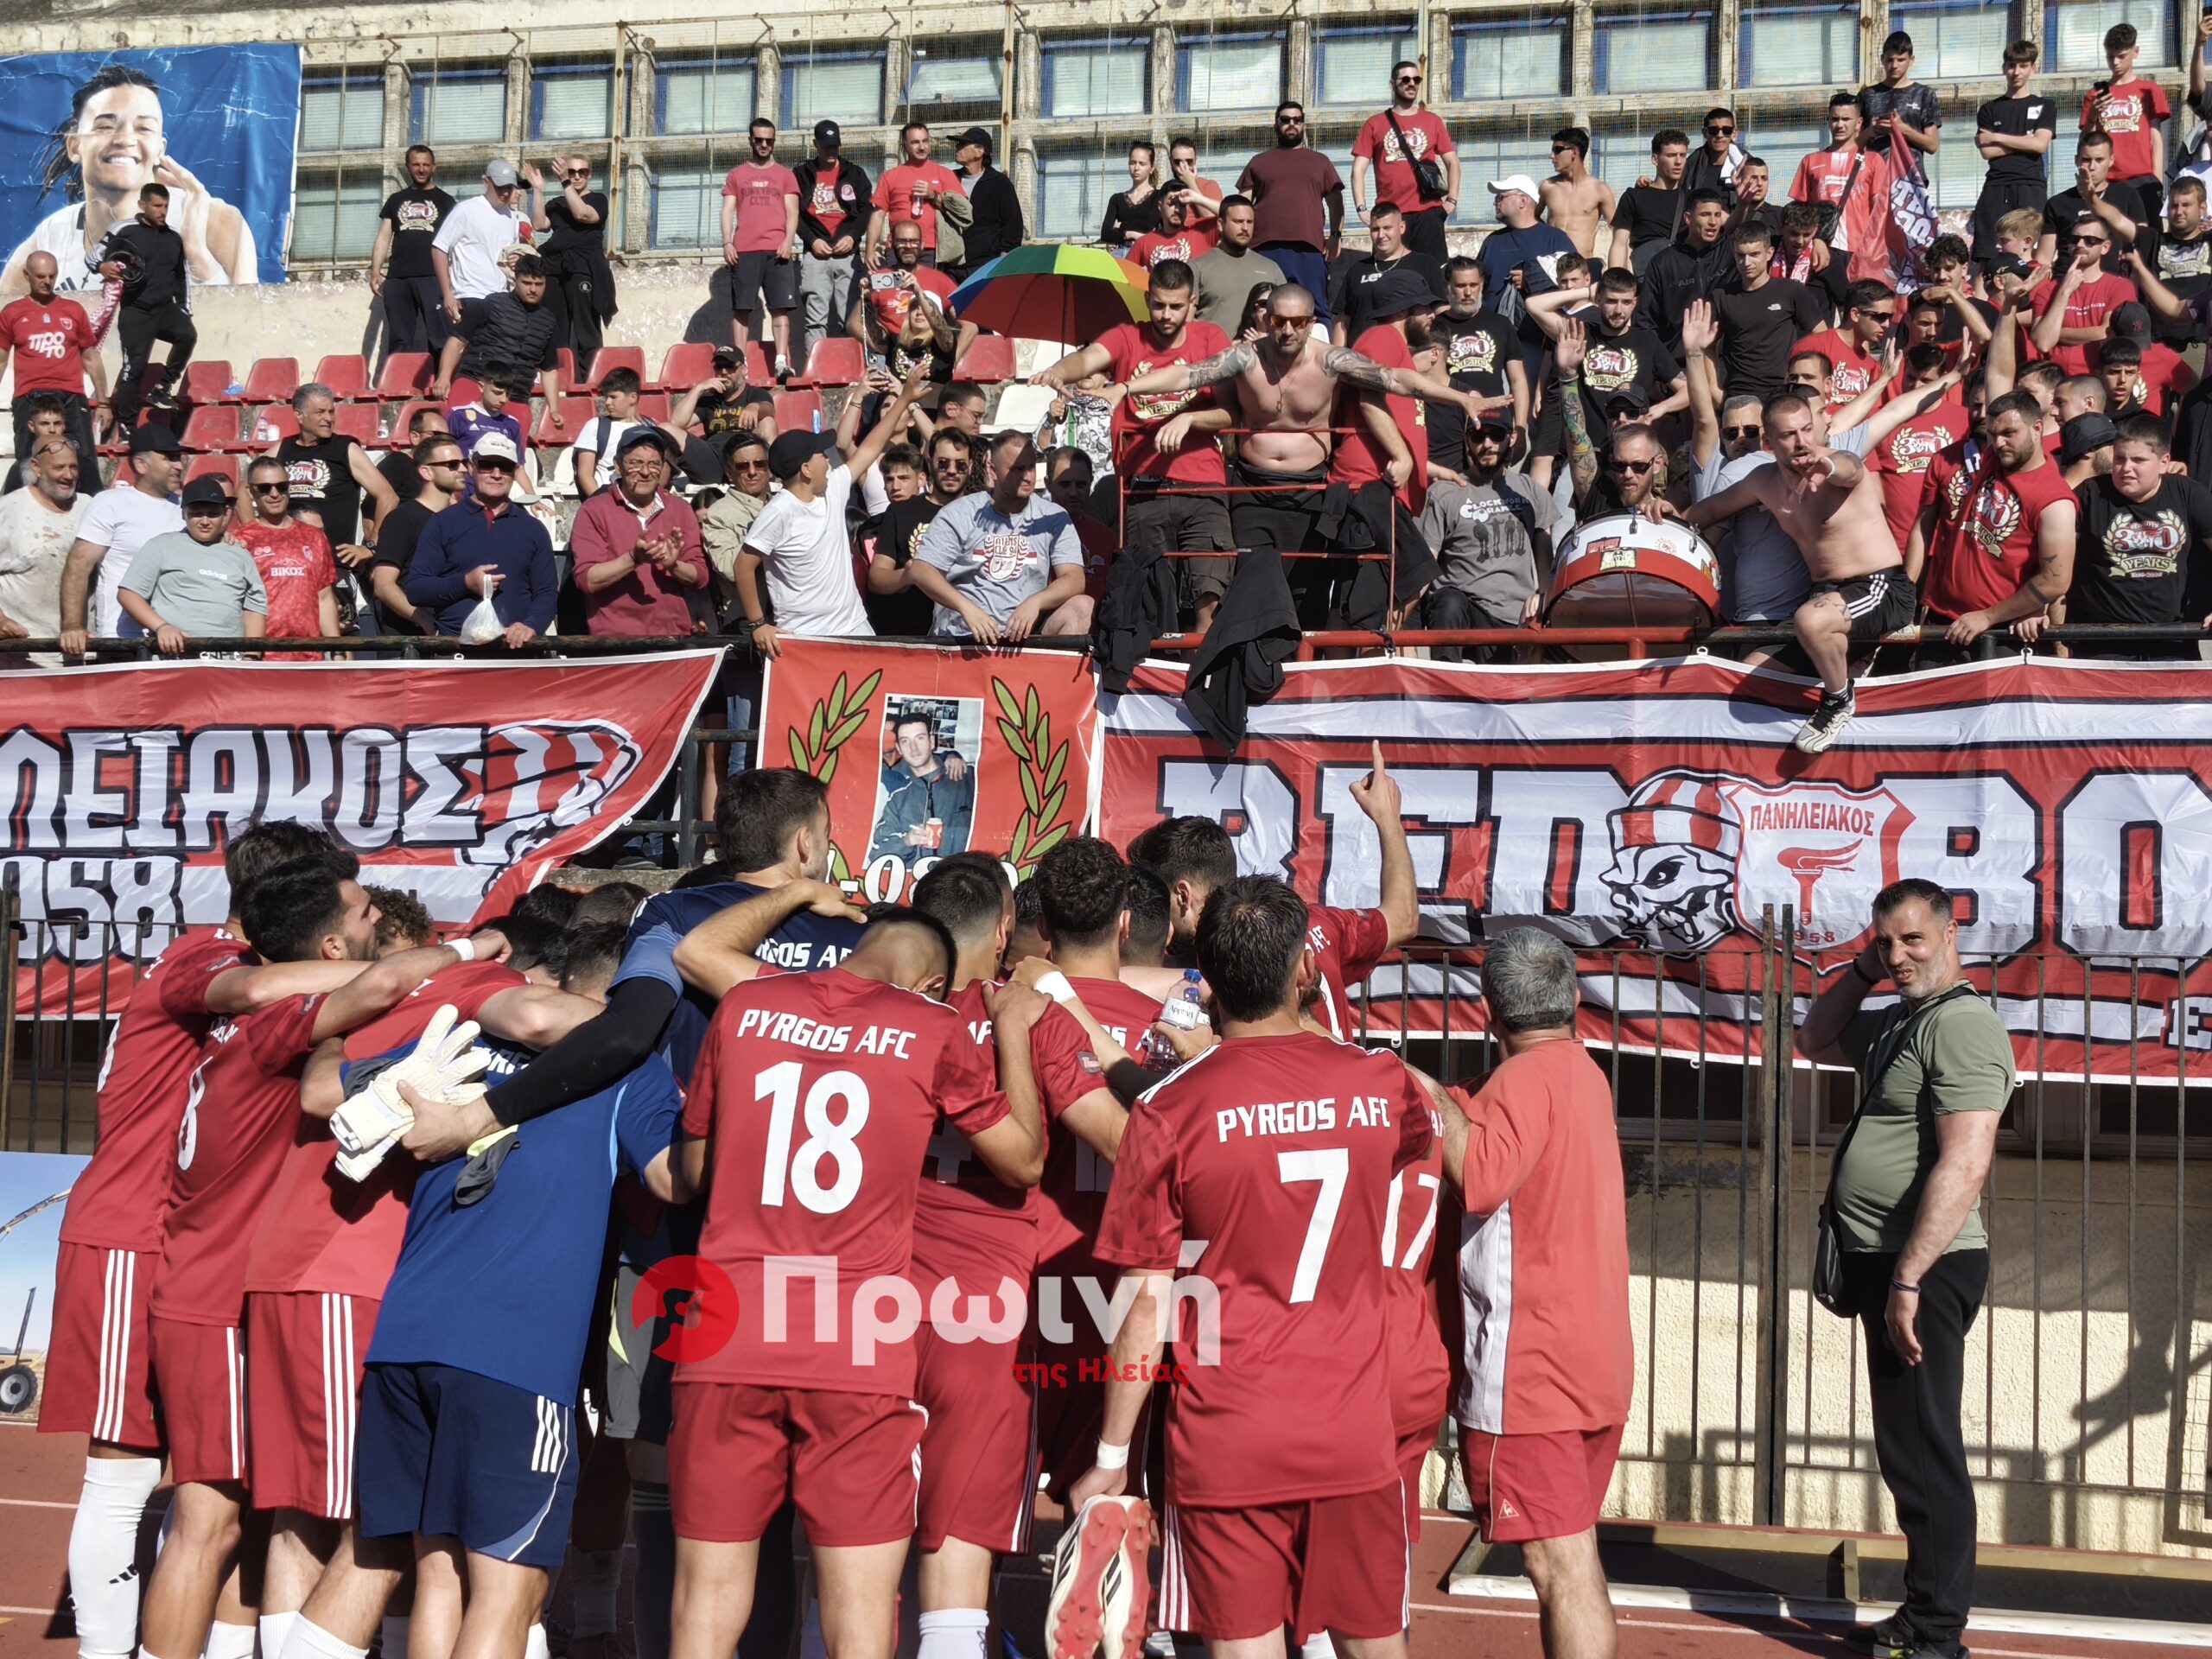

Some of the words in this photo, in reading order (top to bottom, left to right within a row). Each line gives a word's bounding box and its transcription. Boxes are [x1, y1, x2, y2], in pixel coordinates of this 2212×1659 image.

[1589, 352, 1631, 373] 30
[2113, 524, 2180, 551] 30
[199, 569, 228, 580] adidas
[270, 567, 304, 577] ΒΙΚΟΣ
[2126, 557, 2171, 570] YEARS
[1750, 802, 1875, 837] ΠΑΝΗΛΕΙΑΚΟΣ
[1161, 760, 1630, 945] RED
[1792, 929, 1836, 944] 958
[736, 1007, 854, 1054] PYRGOS
[853, 1023, 917, 1060] AFC
[754, 1059, 871, 1214] 18
[1216, 1096, 1336, 1143] PYRGOS
[1276, 1147, 1350, 1304] 7
[1381, 1168, 1440, 1270] 17
